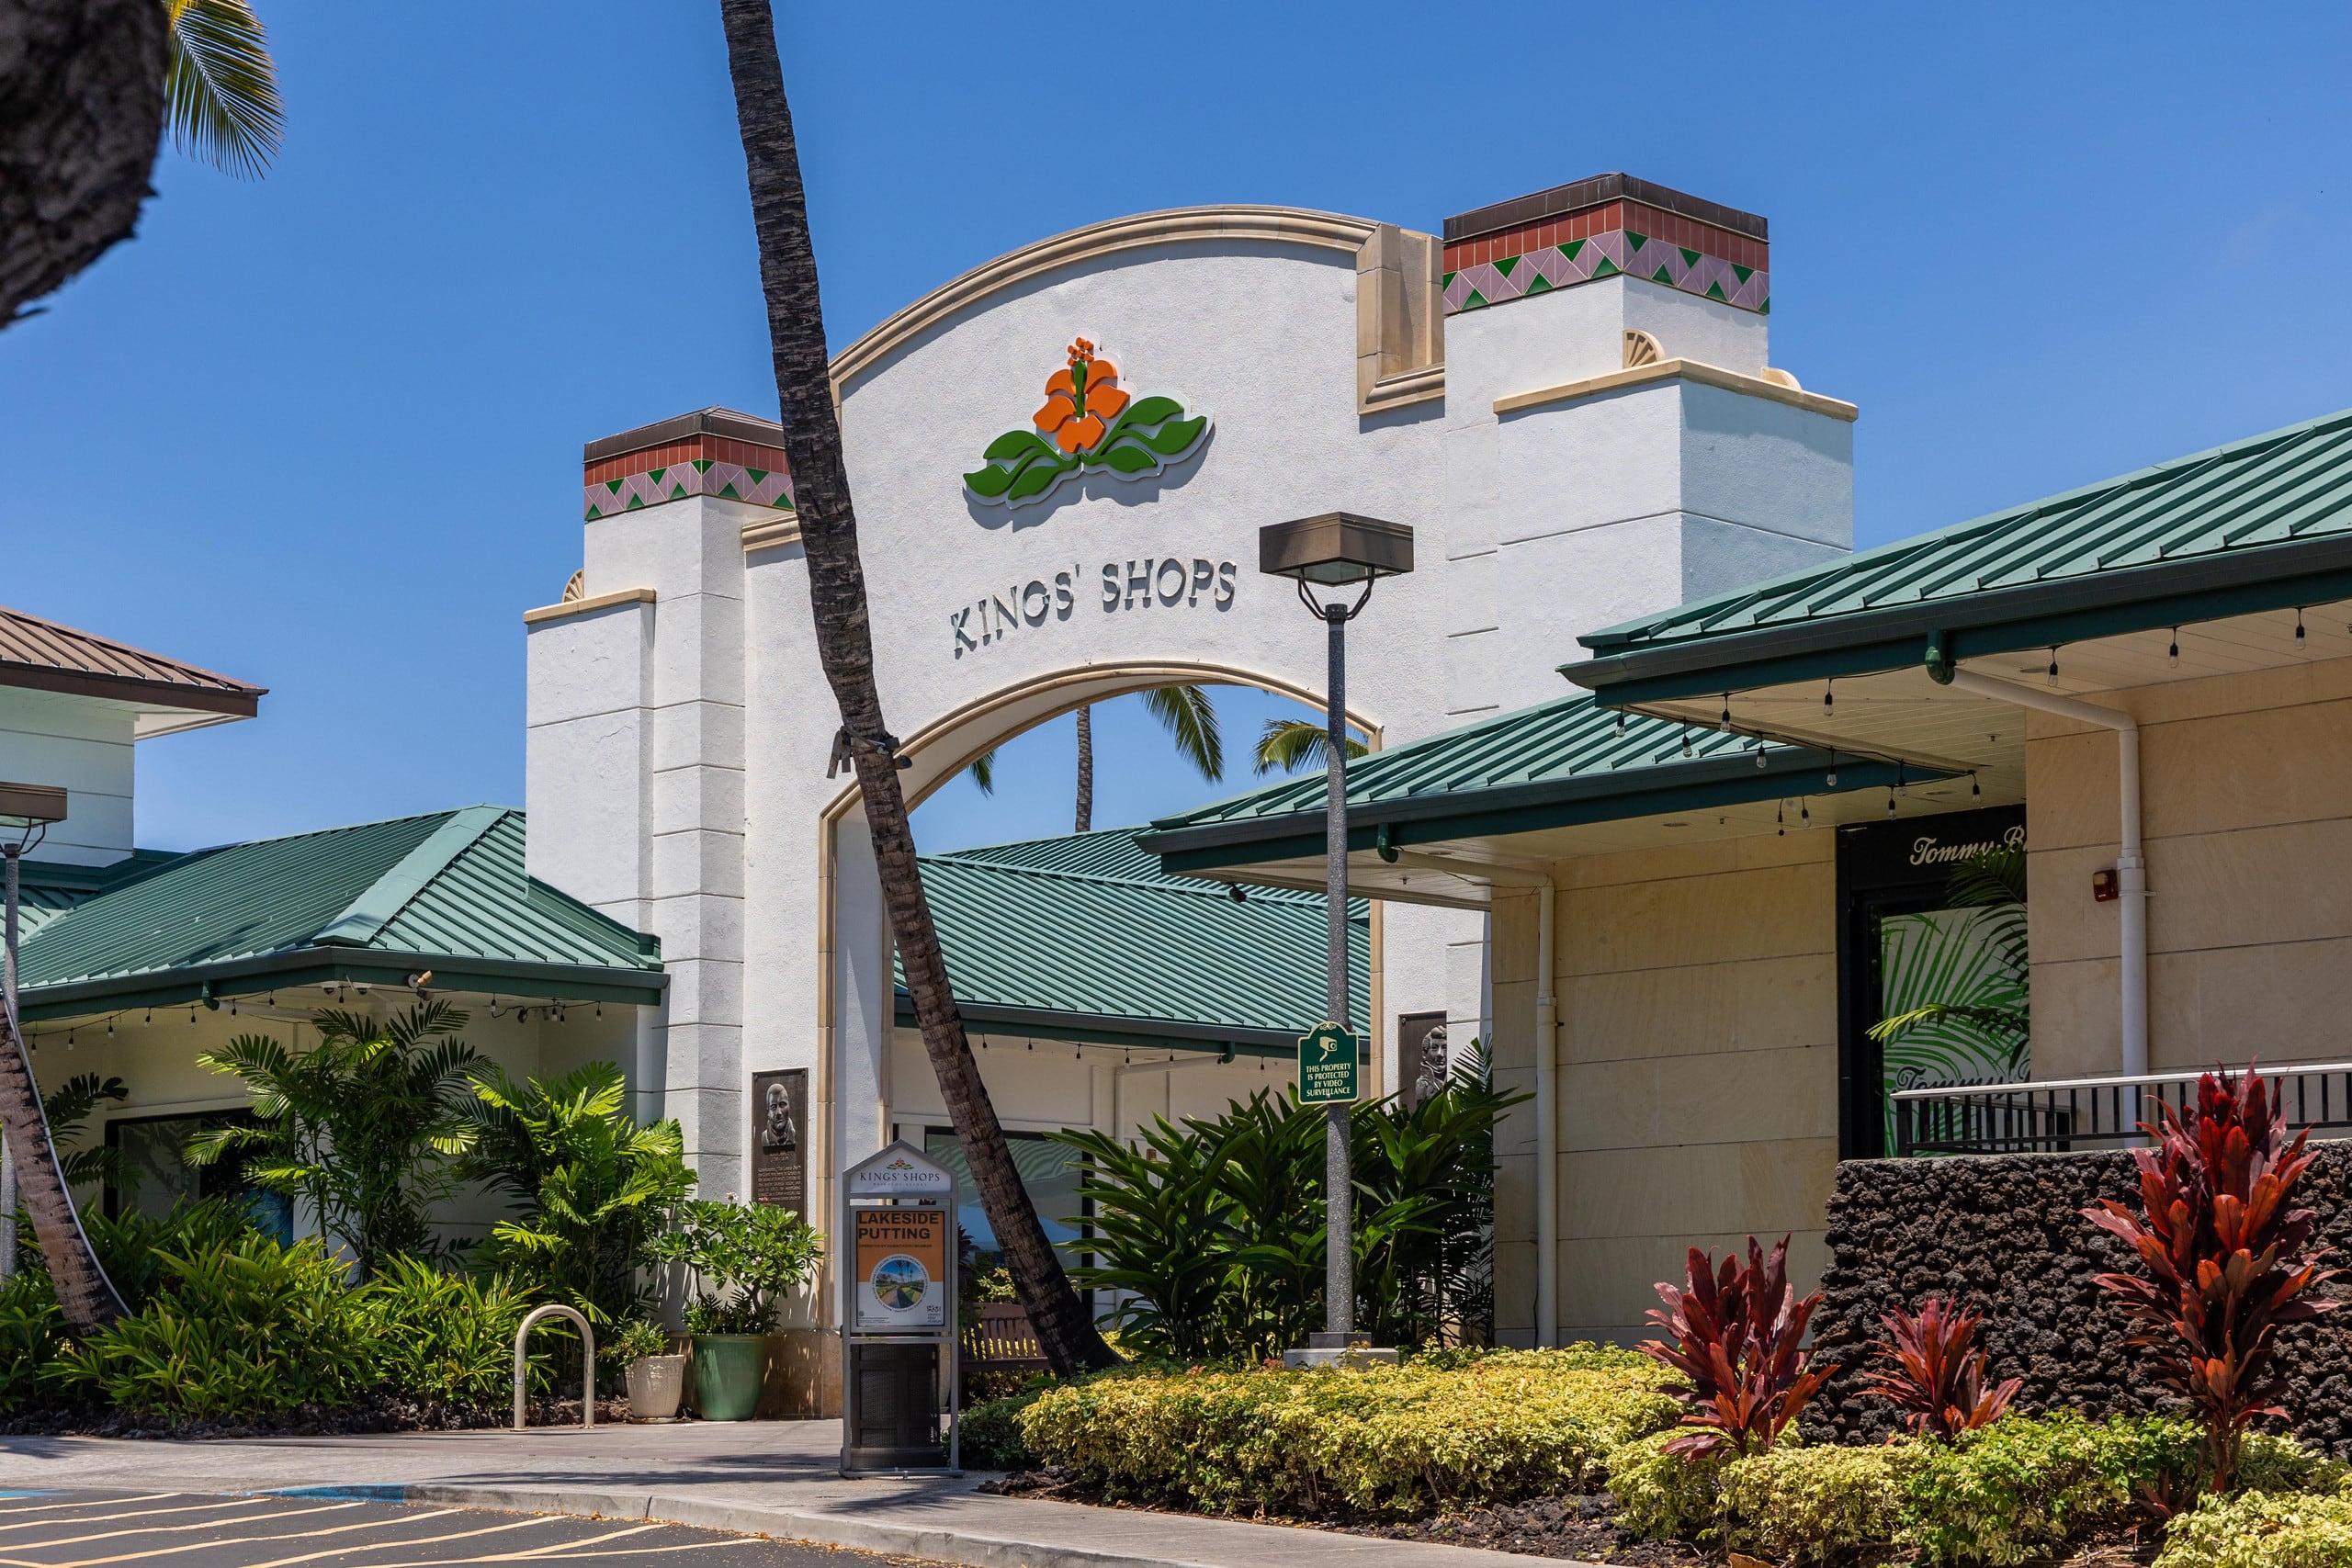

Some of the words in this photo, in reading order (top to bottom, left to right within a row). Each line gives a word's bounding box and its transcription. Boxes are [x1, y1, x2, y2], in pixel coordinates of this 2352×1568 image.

[951, 563, 1080, 657] KINGS'
[1102, 558, 1238, 607] SHOPS
[1909, 837, 2001, 868] Tommy
[1321, 1063, 1351, 1071] PROPERTY
[1315, 1071, 1349, 1079] PROTECTED
[1306, 1087, 1351, 1097] SURVEILLANCE
[860, 1171, 900, 1182] KINGS'
[903, 1172, 941, 1182] SHOPS
[858, 1213, 939, 1224] LAKESIDE
[858, 1227, 931, 1239] PUTTING
